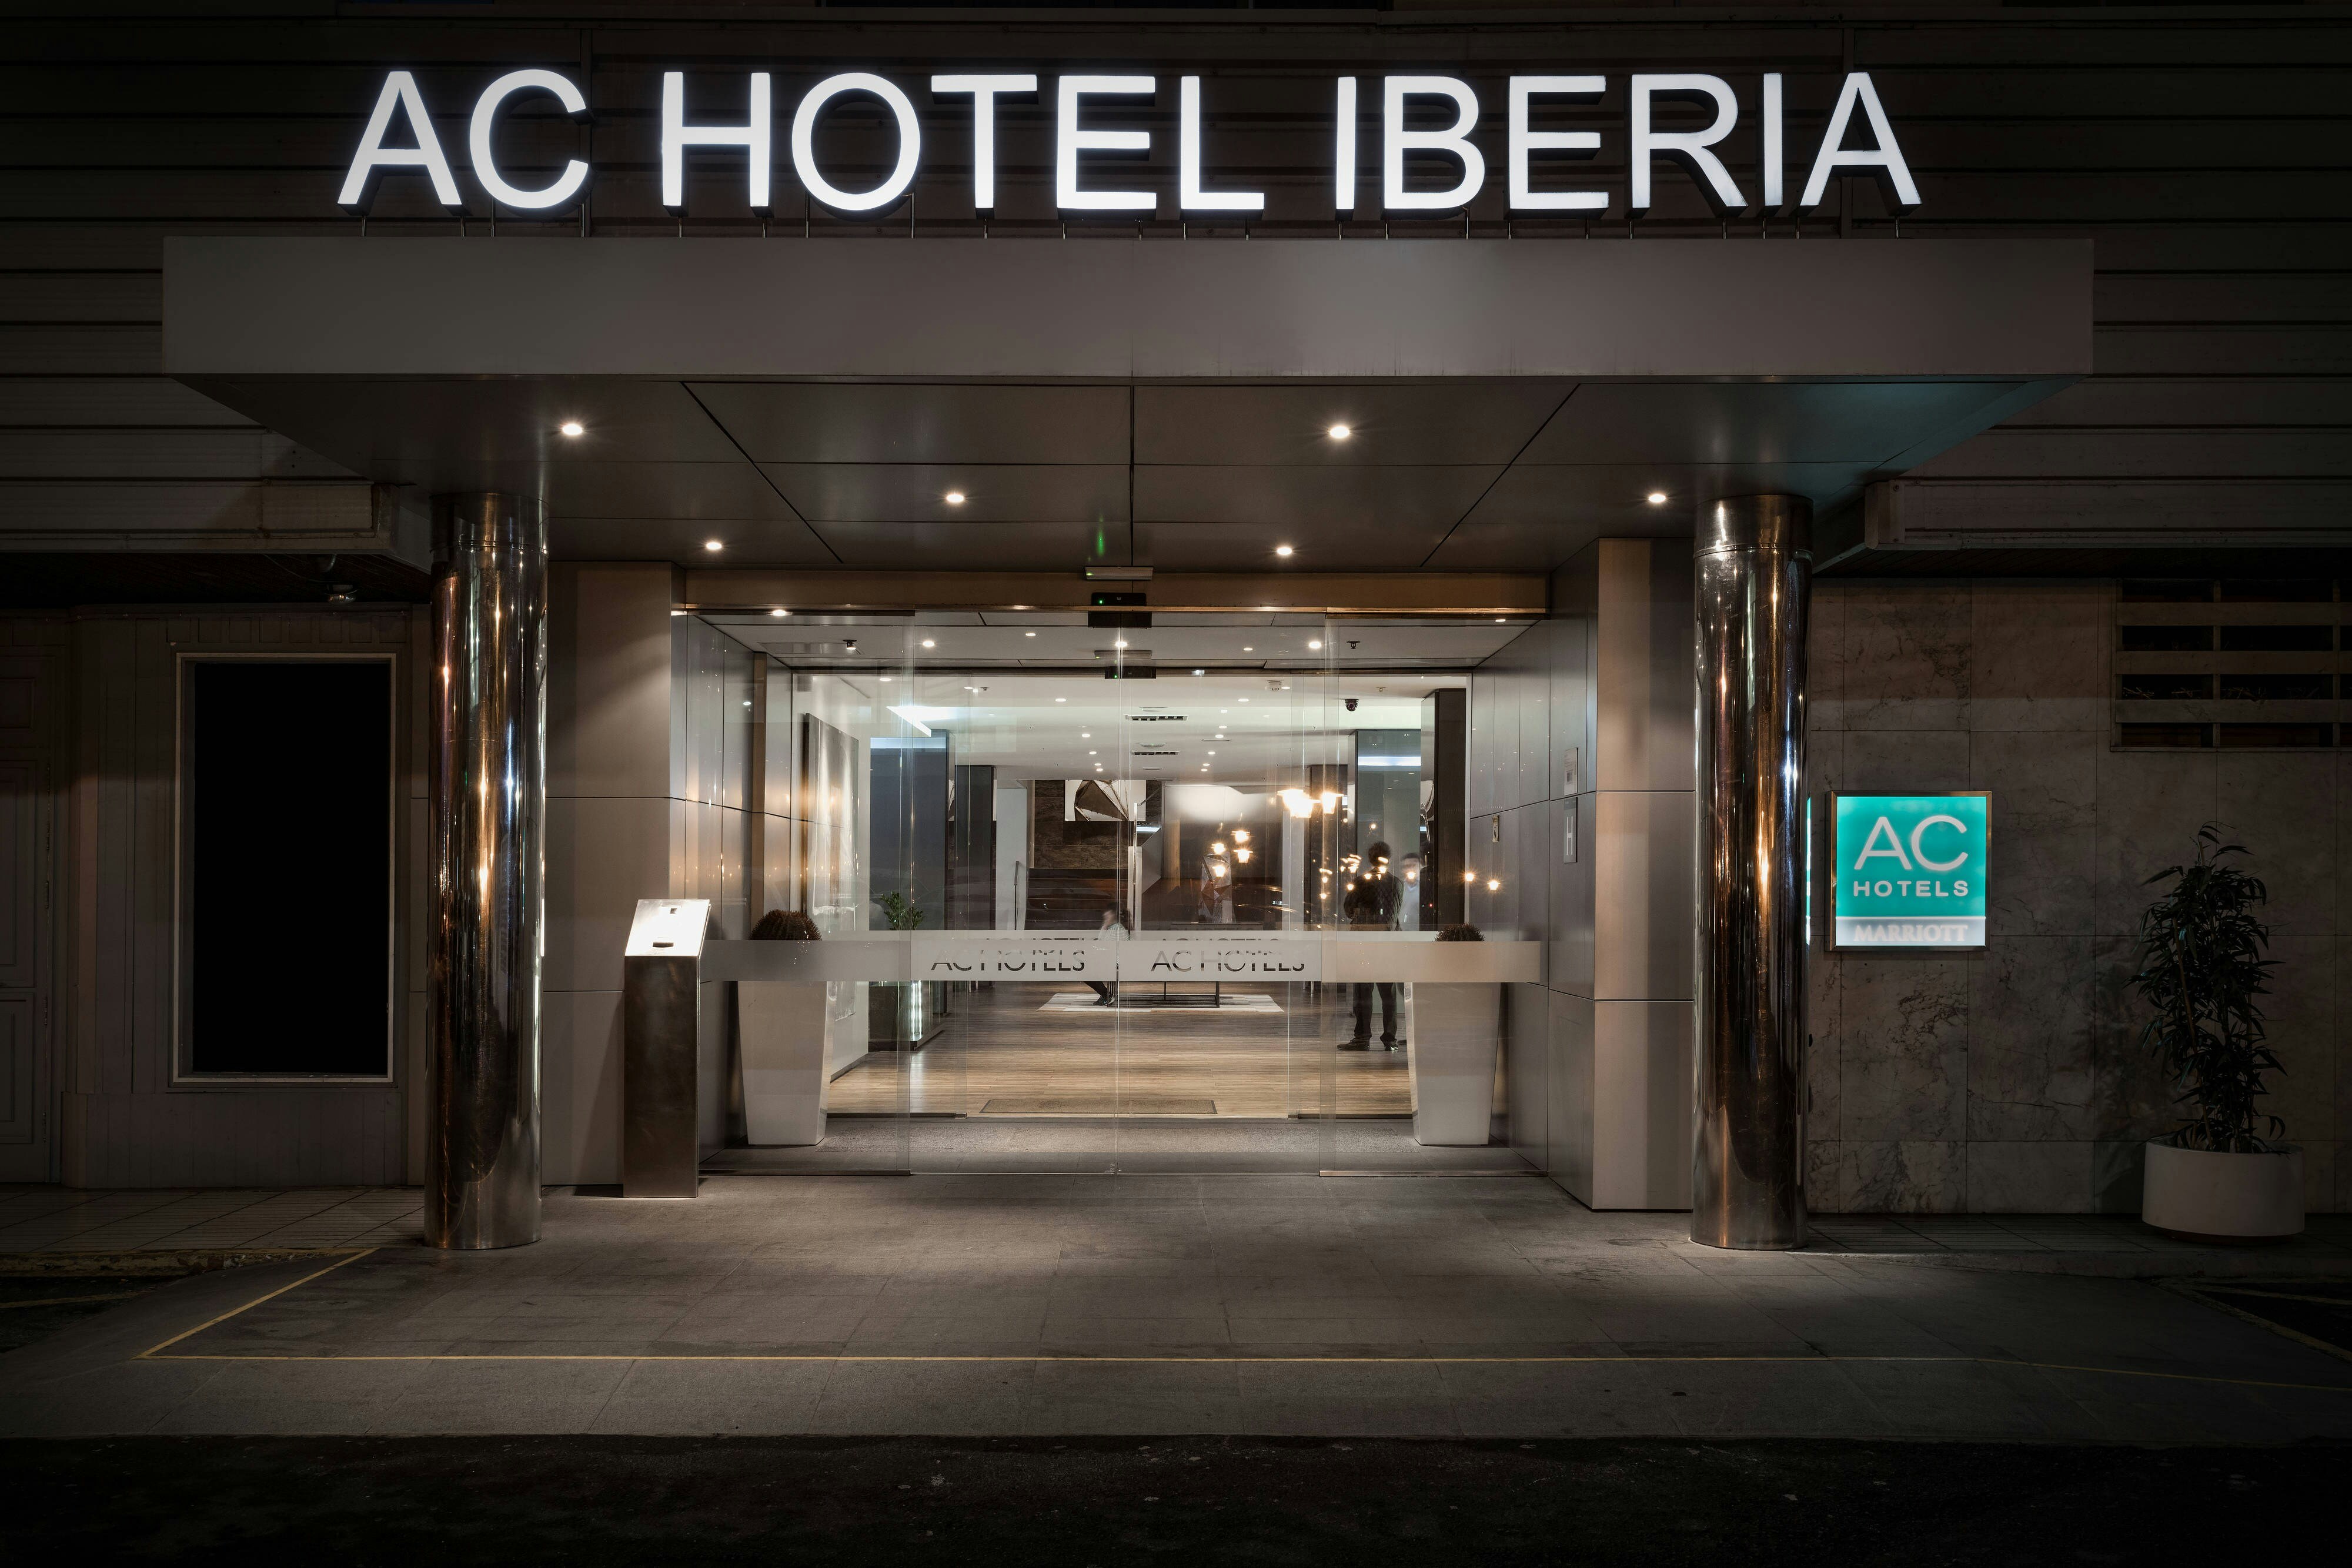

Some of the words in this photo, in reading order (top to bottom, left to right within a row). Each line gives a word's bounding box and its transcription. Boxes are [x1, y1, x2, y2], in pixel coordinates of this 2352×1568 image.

[338, 69, 589, 209] AC
[661, 72, 1265, 211] HOTEL
[1336, 72, 1921, 210] IBERIA
[1854, 815, 1969, 871] AC
[1853, 881, 1969, 897] HOTELS
[1853, 925, 1969, 942] MARRIOTT
[1150, 950, 1192, 972] AC
